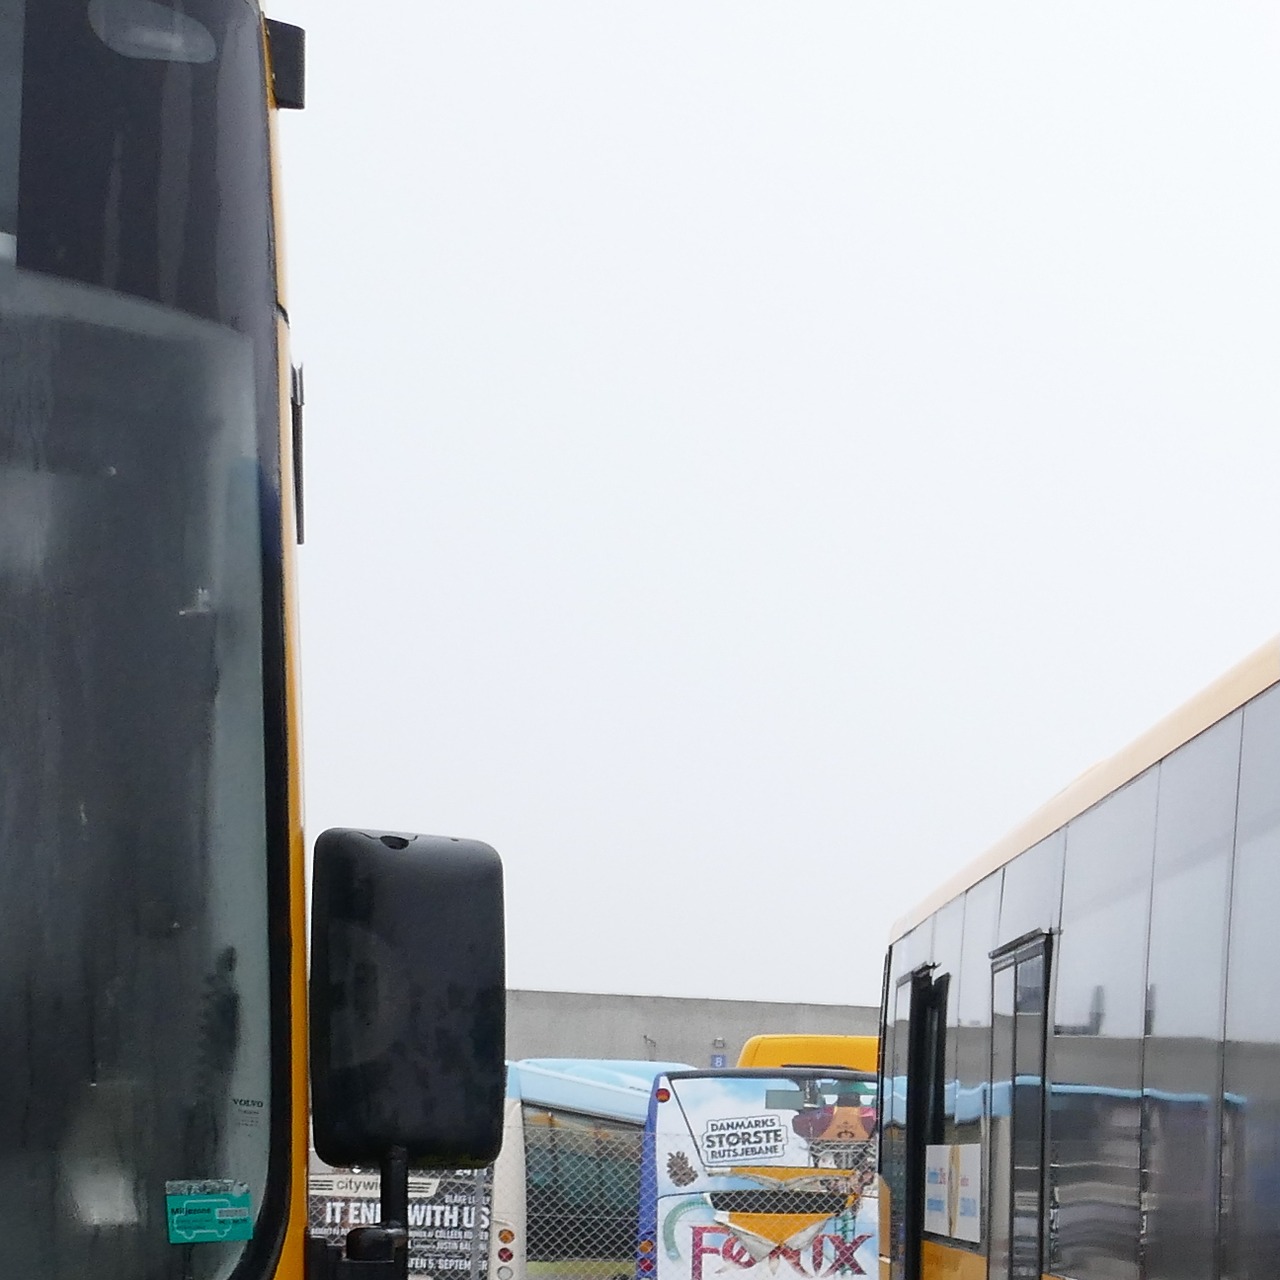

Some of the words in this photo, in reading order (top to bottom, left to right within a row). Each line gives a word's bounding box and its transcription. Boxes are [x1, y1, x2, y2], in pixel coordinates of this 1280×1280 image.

[232, 1098, 264, 1108] VOLVO
[710, 1118, 776, 1133] DANMARKS
[705, 1129, 783, 1149] STØRSTE
[710, 1145, 779, 1160] RUTSJEBANE
[408, 1204, 458, 1229] WITH
